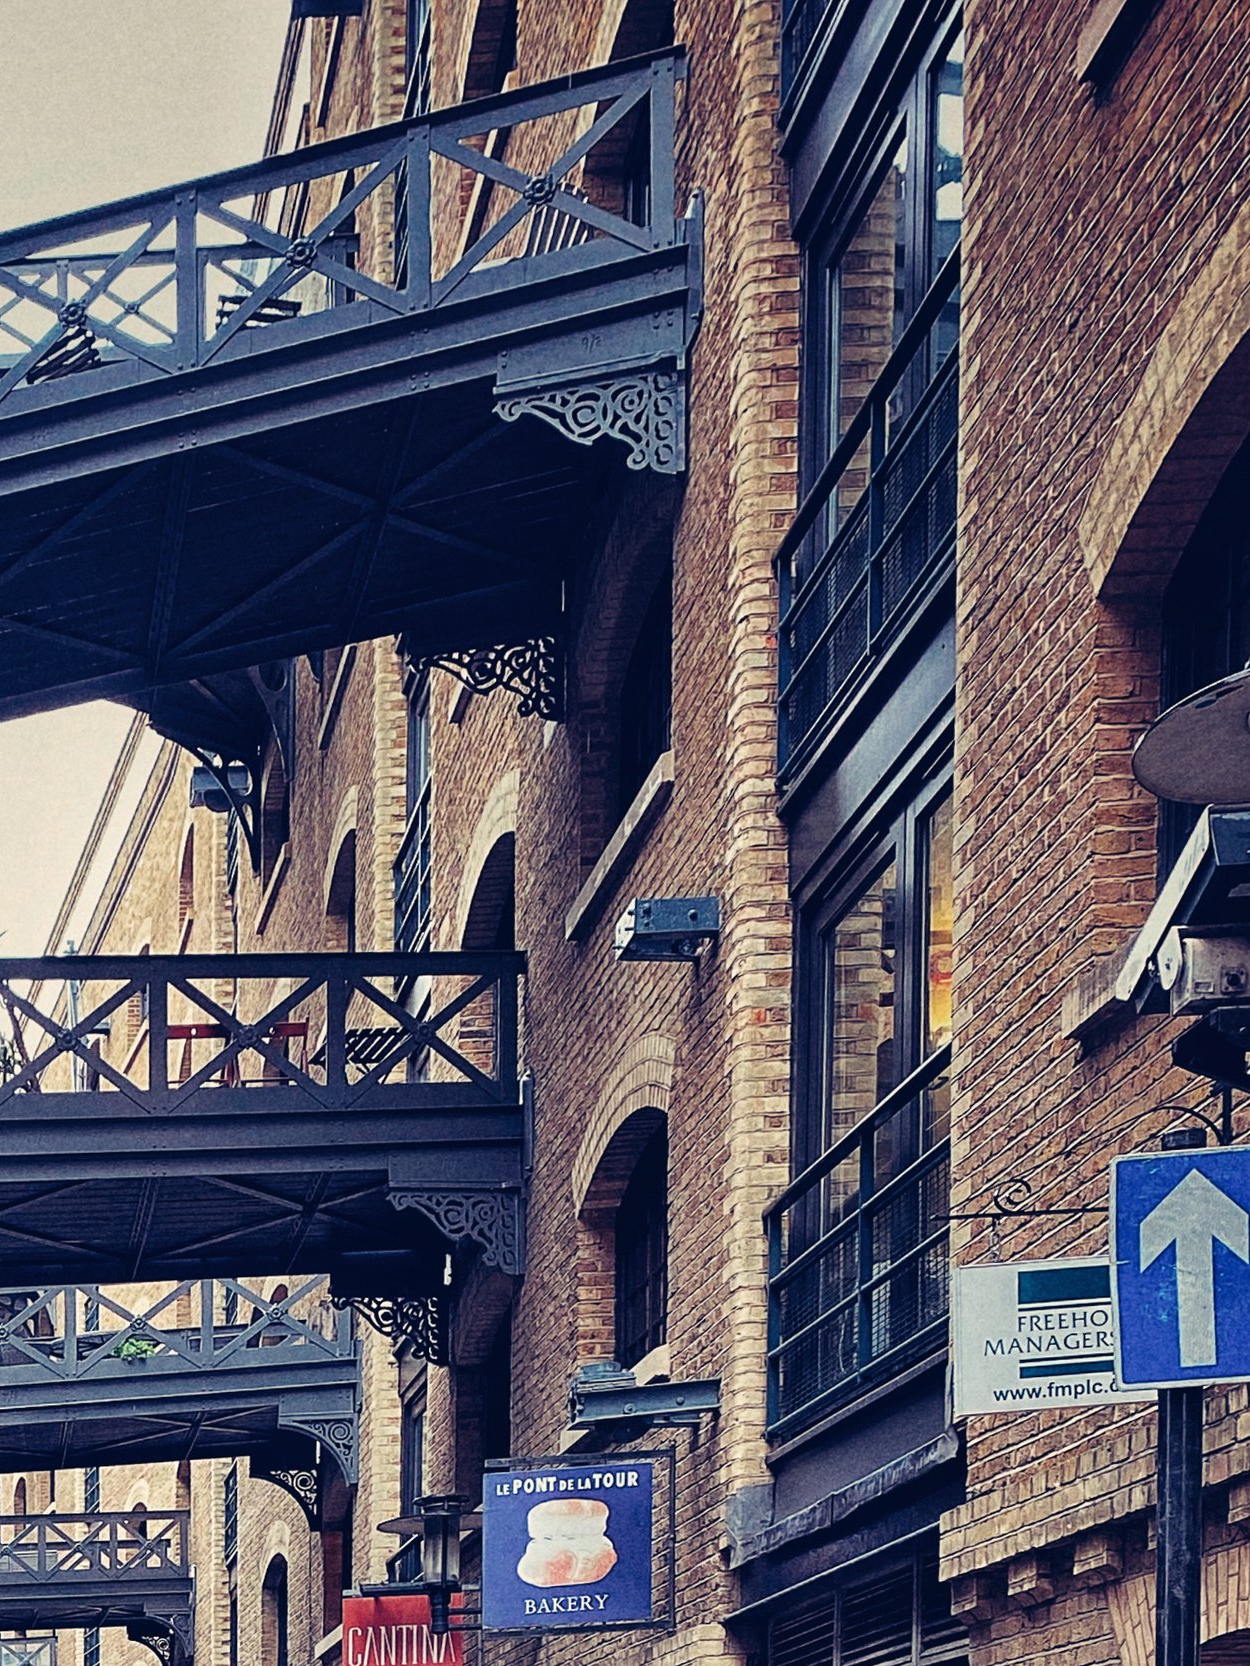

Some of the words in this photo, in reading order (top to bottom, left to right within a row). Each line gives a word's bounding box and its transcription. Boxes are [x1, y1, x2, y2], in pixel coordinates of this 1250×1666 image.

[496, 1484, 510, 1496] LE
[512, 1476, 557, 1494] PONT
[559, 1479, 575, 1491] DE
[577, 1478, 591, 1490] LA
[592, 1471, 638, 1488] TOUR
[525, 1594, 609, 1615] BAKERY
[348, 1624, 456, 1666] CANTINA
